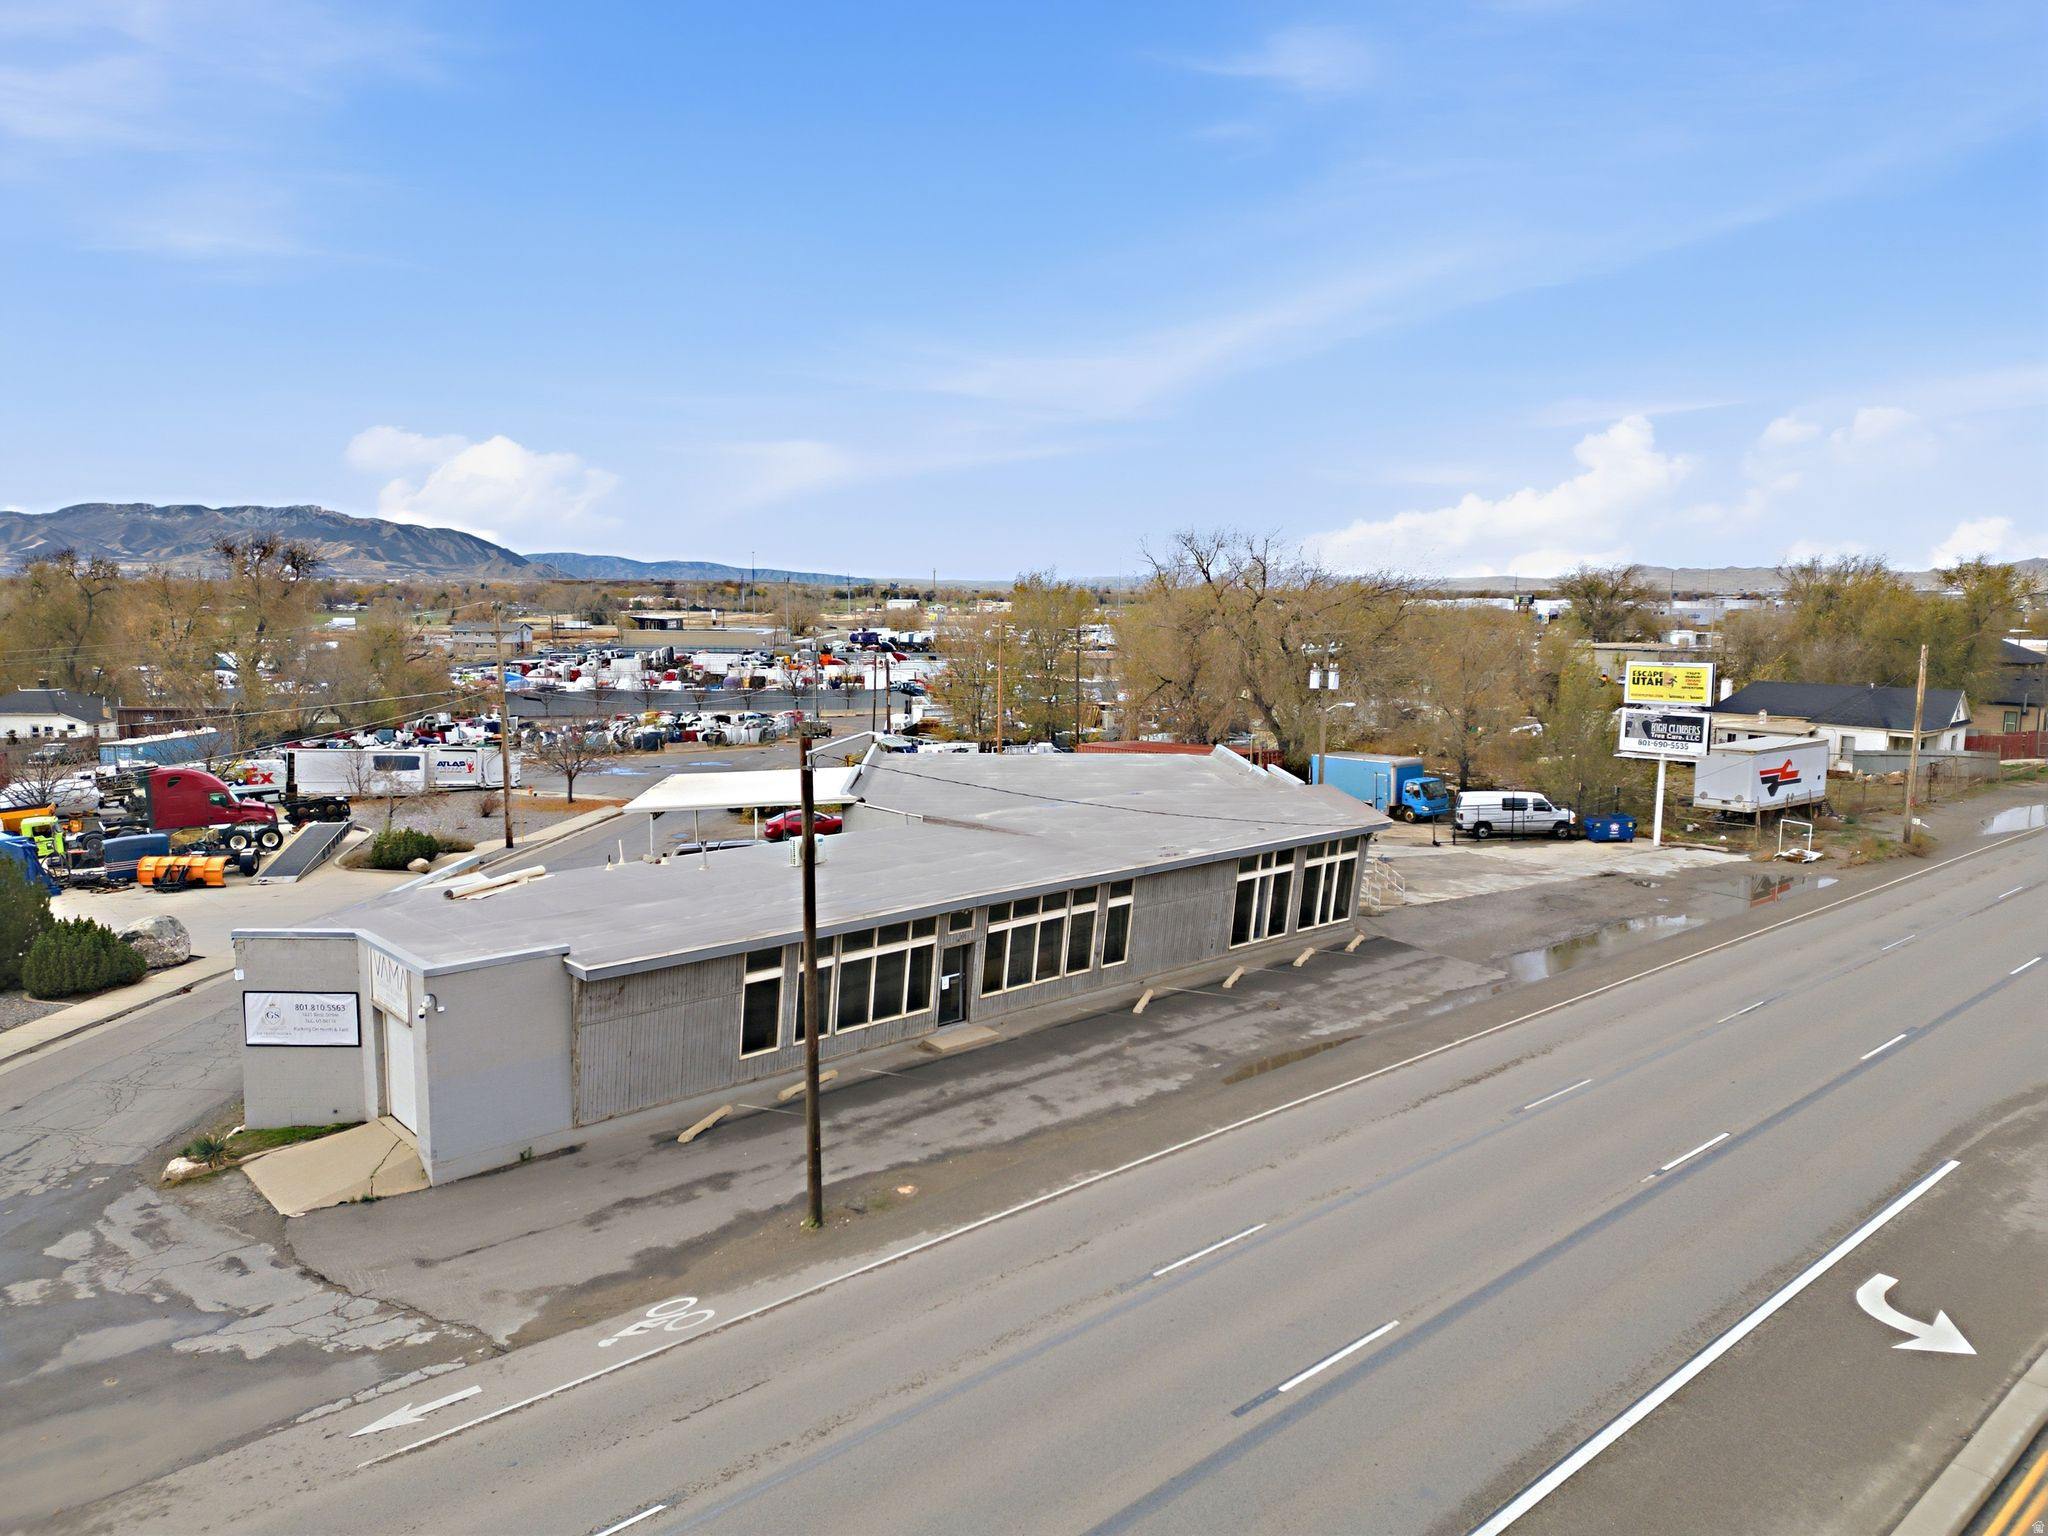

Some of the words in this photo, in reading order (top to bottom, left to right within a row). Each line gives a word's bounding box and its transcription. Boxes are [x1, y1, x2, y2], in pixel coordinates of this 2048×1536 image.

[1632, 670, 1663, 678] ESCAPE
[1632, 676, 1663, 686] UTAH
[1651, 722, 1667, 733] HIGH
[1668, 724, 1701, 735] CLIMBERS
[1638, 739, 1689, 750] 801-690-5535
[294, 1003, 346, 1012] 801.810.5563
